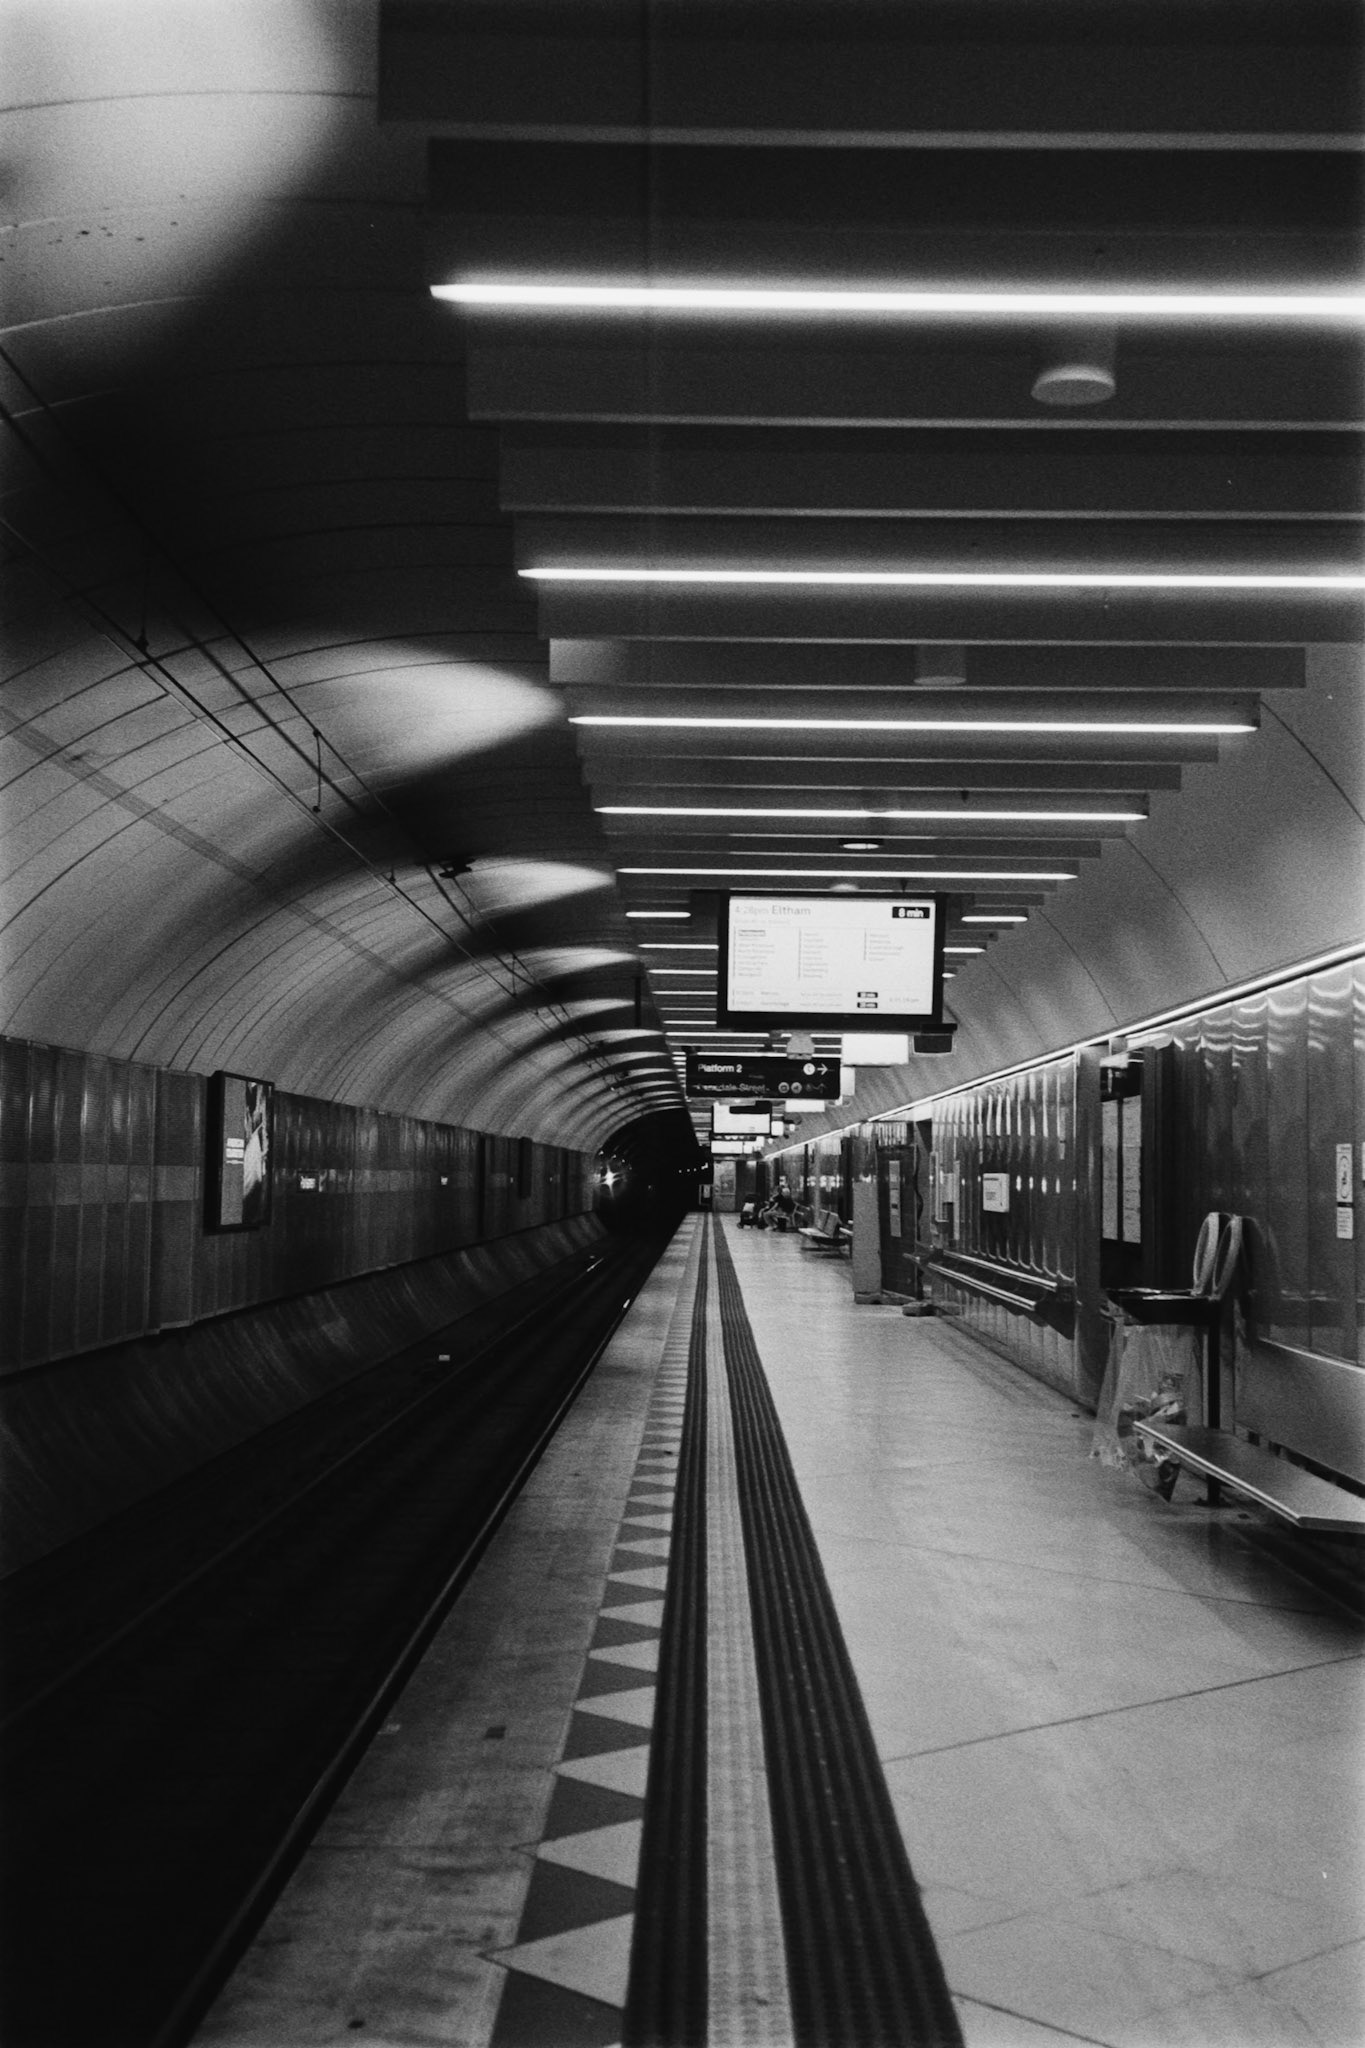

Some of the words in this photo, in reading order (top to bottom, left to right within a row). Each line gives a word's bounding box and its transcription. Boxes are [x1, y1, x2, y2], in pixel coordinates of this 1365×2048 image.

[771, 905, 811, 915] Eltham
[906, 907, 924, 918] min
[697, 1063, 735, 1073] Platform
[736, 1063, 743, 1073] 2
[697, 1083, 737, 1092] dale
